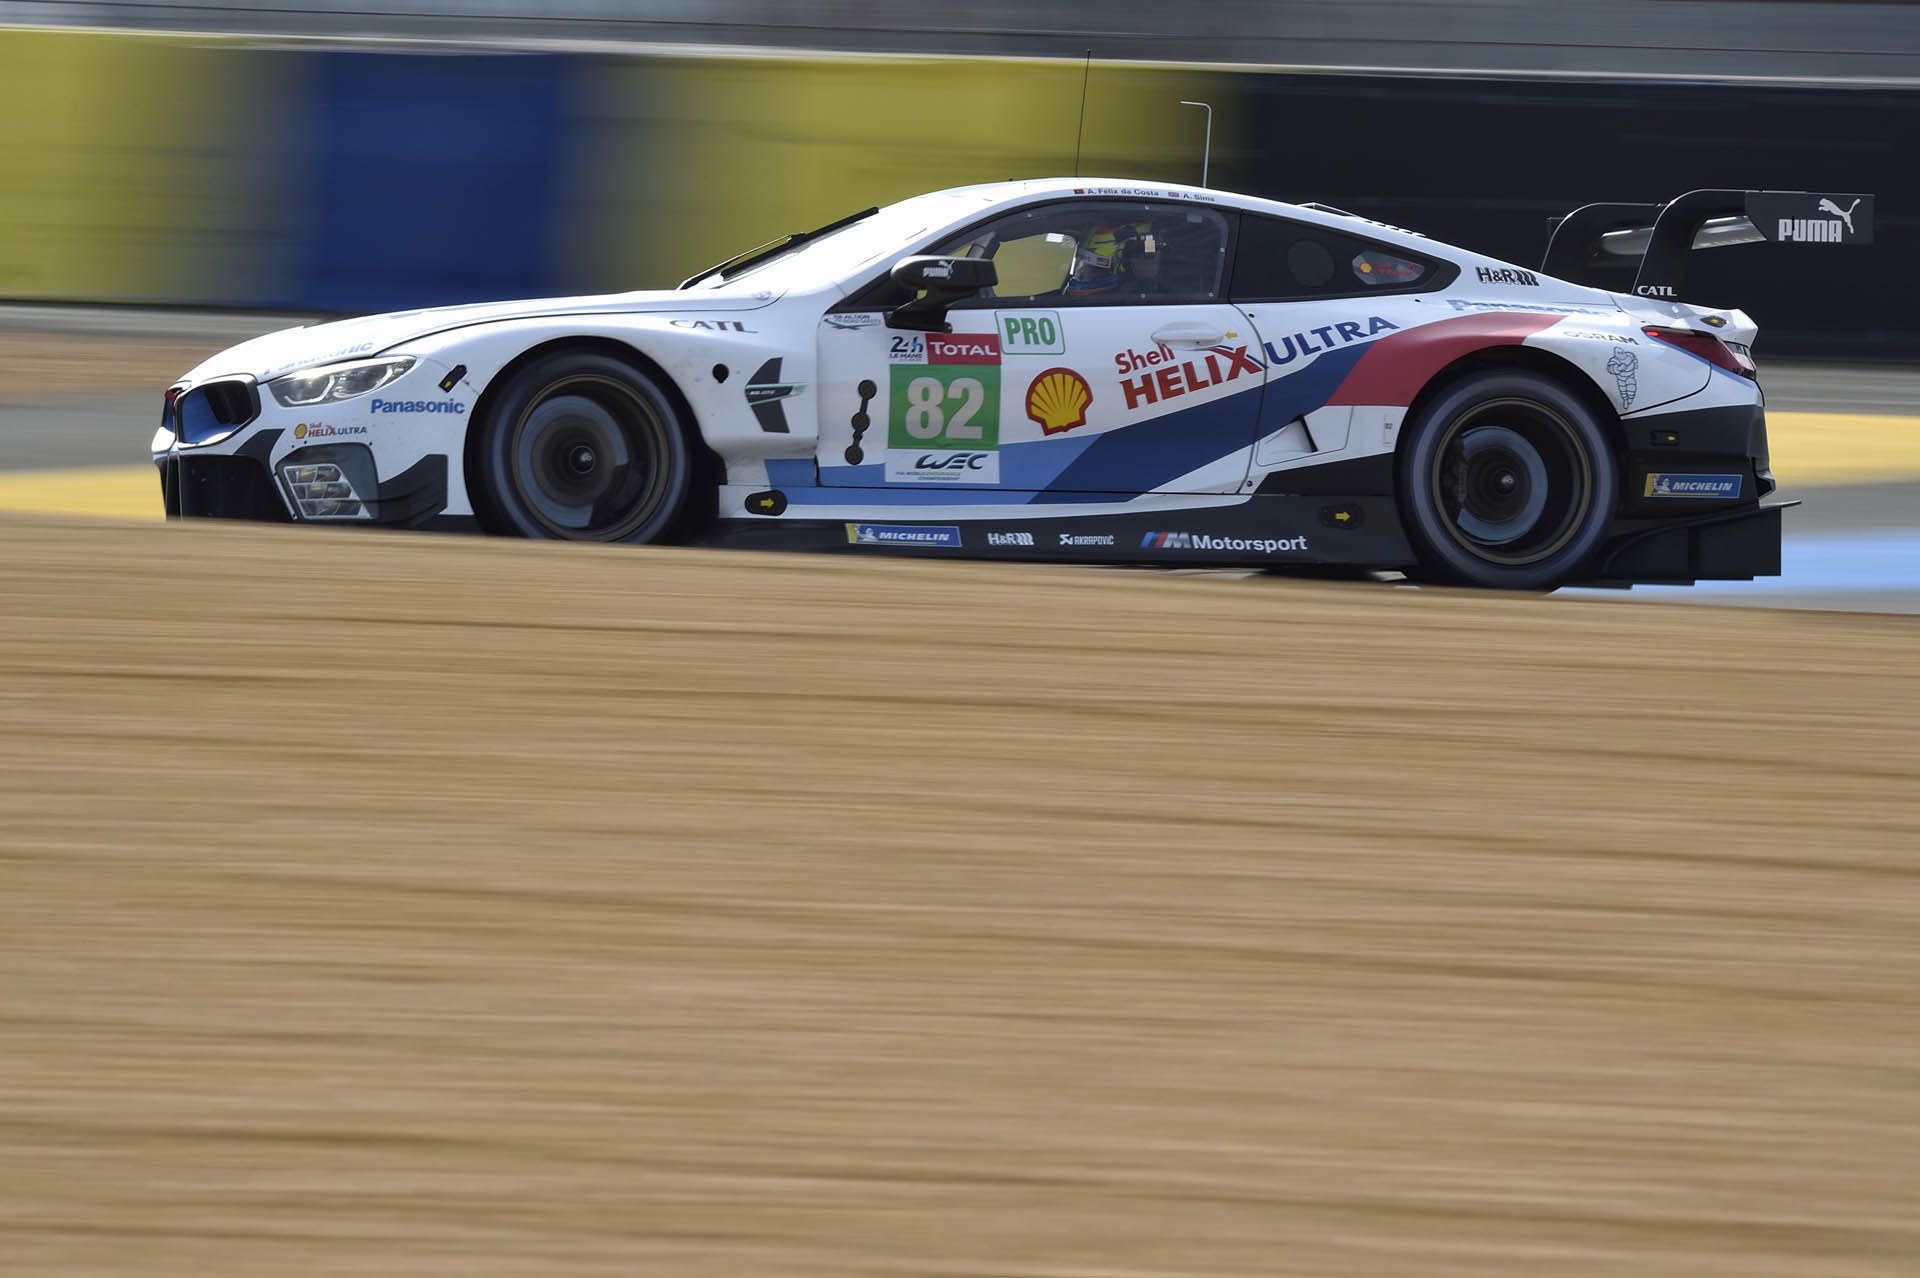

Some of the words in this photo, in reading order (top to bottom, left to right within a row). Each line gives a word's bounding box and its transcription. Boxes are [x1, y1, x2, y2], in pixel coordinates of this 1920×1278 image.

[1134, 188, 1159, 197] Costa
[1778, 219, 1842, 242] PUMA
[923, 267, 949, 277] PUMA
[1477, 267, 1514, 283] H&R
[1637, 285, 1678, 296] CATL
[669, 319, 758, 333] CATL
[1004, 317, 1056, 345] PRO
[891, 336, 923, 352] 24h
[1563, 331, 1639, 346] OSRAM
[929, 341, 998, 356] TOTAL
[1115, 343, 1175, 374] Shell
[1119, 345, 1264, 410] HELIX
[1264, 316, 1400, 366] ULTRA
[370, 398, 465, 414] Panasonic
[905, 377, 984, 439] 82
[308, 424, 336, 437] HELIX
[337, 426, 367, 435] ULTRA
[914, 453, 989, 469] WEC
[1672, 482, 1732, 490] MICHELIN
[879, 531, 950, 541] MICHELIN
[987, 533, 1016, 545] H&R
[1192, 535, 1308, 553] Motorsport
